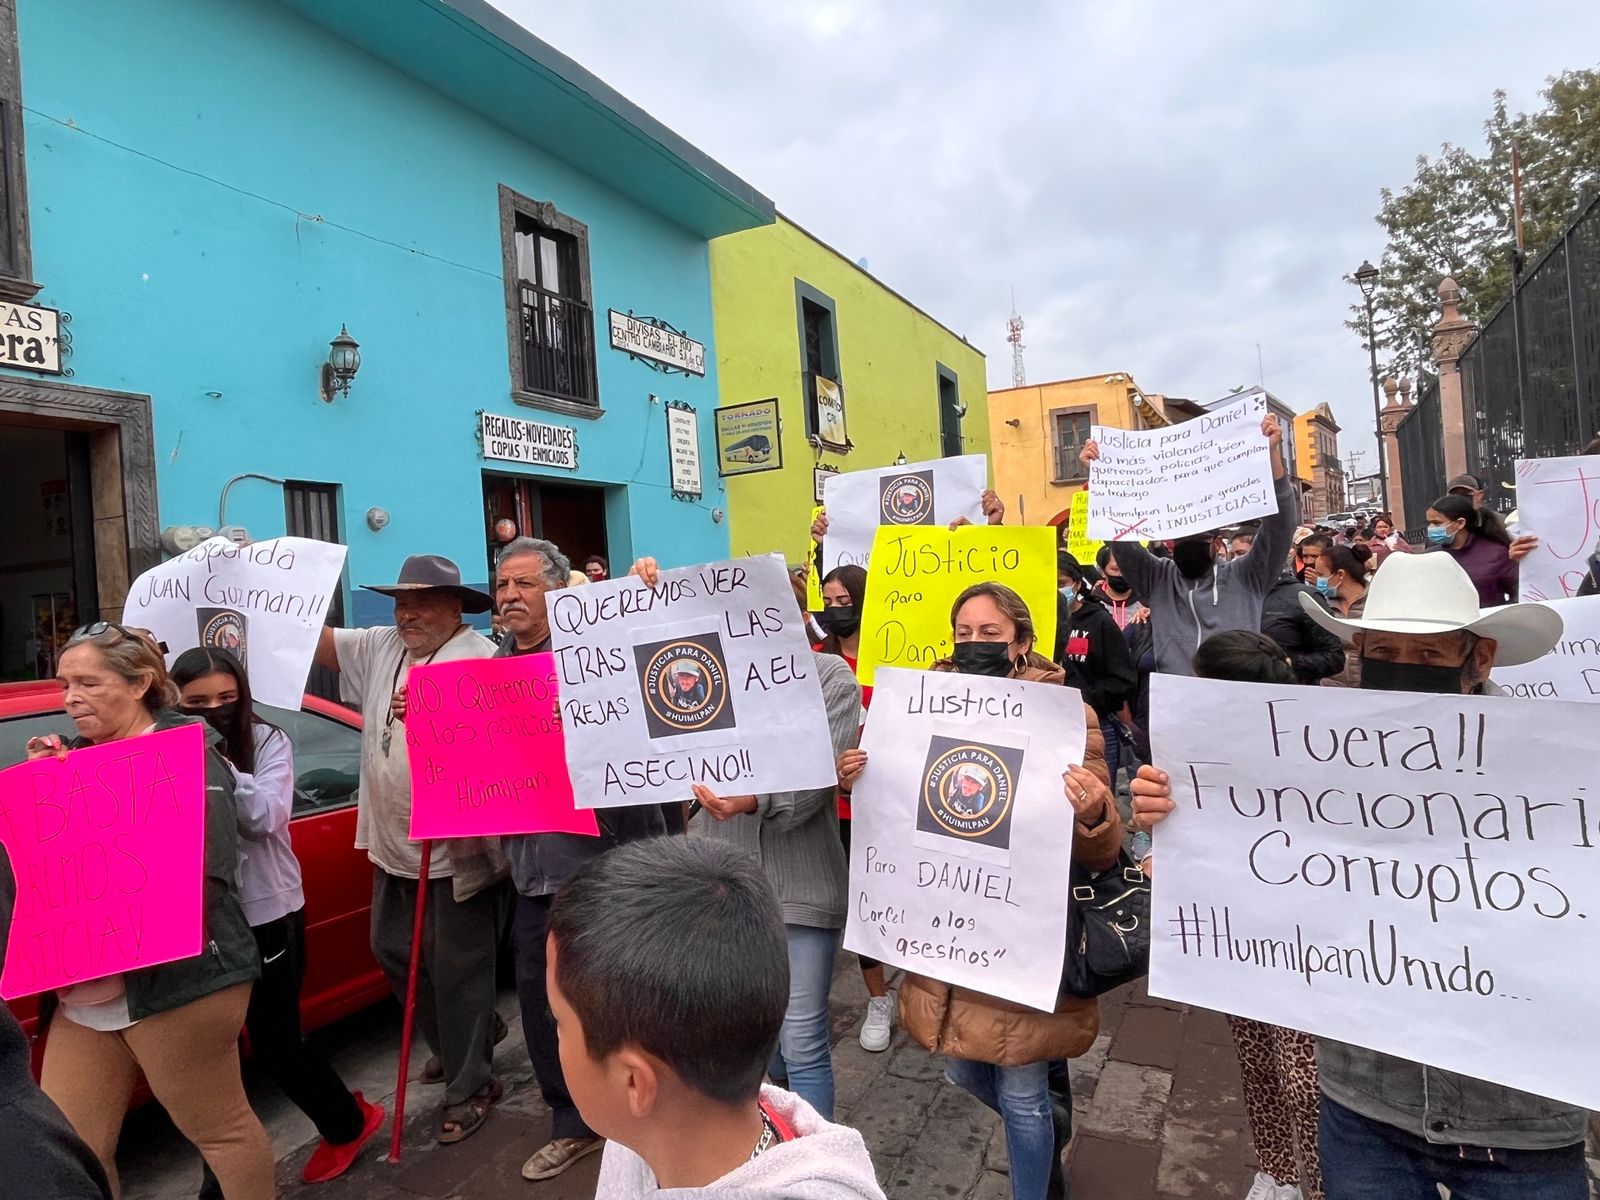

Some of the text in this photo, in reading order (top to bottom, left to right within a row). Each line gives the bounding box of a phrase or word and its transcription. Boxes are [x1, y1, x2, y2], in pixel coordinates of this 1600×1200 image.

[612, 326, 641, 345] CENTRO
[643, 336, 676, 358] CAMBIARIO
[627, 319, 661, 340] DIVISAS
[721, 408, 771, 421] TORNADO
[1092, 403, 1247, 450] Justicia para Daniel
[491, 440, 569, 465] COPIAS Y ENMICADOS
[1091, 465, 1152, 480] queremos
[1218, 440, 1245, 454] bien
[1091, 476, 1168, 488] capacitados
[1174, 469, 1199, 482] para
[1203, 460, 1223, 473] que
[1200, 494, 1213, 504] de
[1218, 477, 1262, 501] grandes
[140, 576, 190, 607] JUAN
[553, 567, 750, 636] QUEREMOS VER
[884, 590, 923, 611] para
[724, 607, 784, 639] LAS
[875, 620, 947, 664] Dani
[648, 647, 722, 695] #JUSTICIA PARA DANIEL
[564, 697, 630, 728] REJAS
[665, 703, 716, 723] #HUIMILPAN
[907, 675, 1024, 718] Justicia
[1265, 698, 1486, 776] Fuera!!
[424, 756, 448, 786] de
[456, 770, 550, 811] Huimilpan
[603, 748, 754, 796] ASECINO!!
[929, 751, 1008, 802] #JUSTICIA PARA DANIEL
[31, 751, 181, 843] BASTA
[1186, 761, 1600, 848] Funcionari
[937, 809, 990, 829] #HUIMILPAN
[17, 832, 148, 918] EREMOS
[916, 861, 1020, 908] DANIEL
[1248, 829, 1588, 923] Corruptos.
[7, 904, 143, 992] USTICIA!
